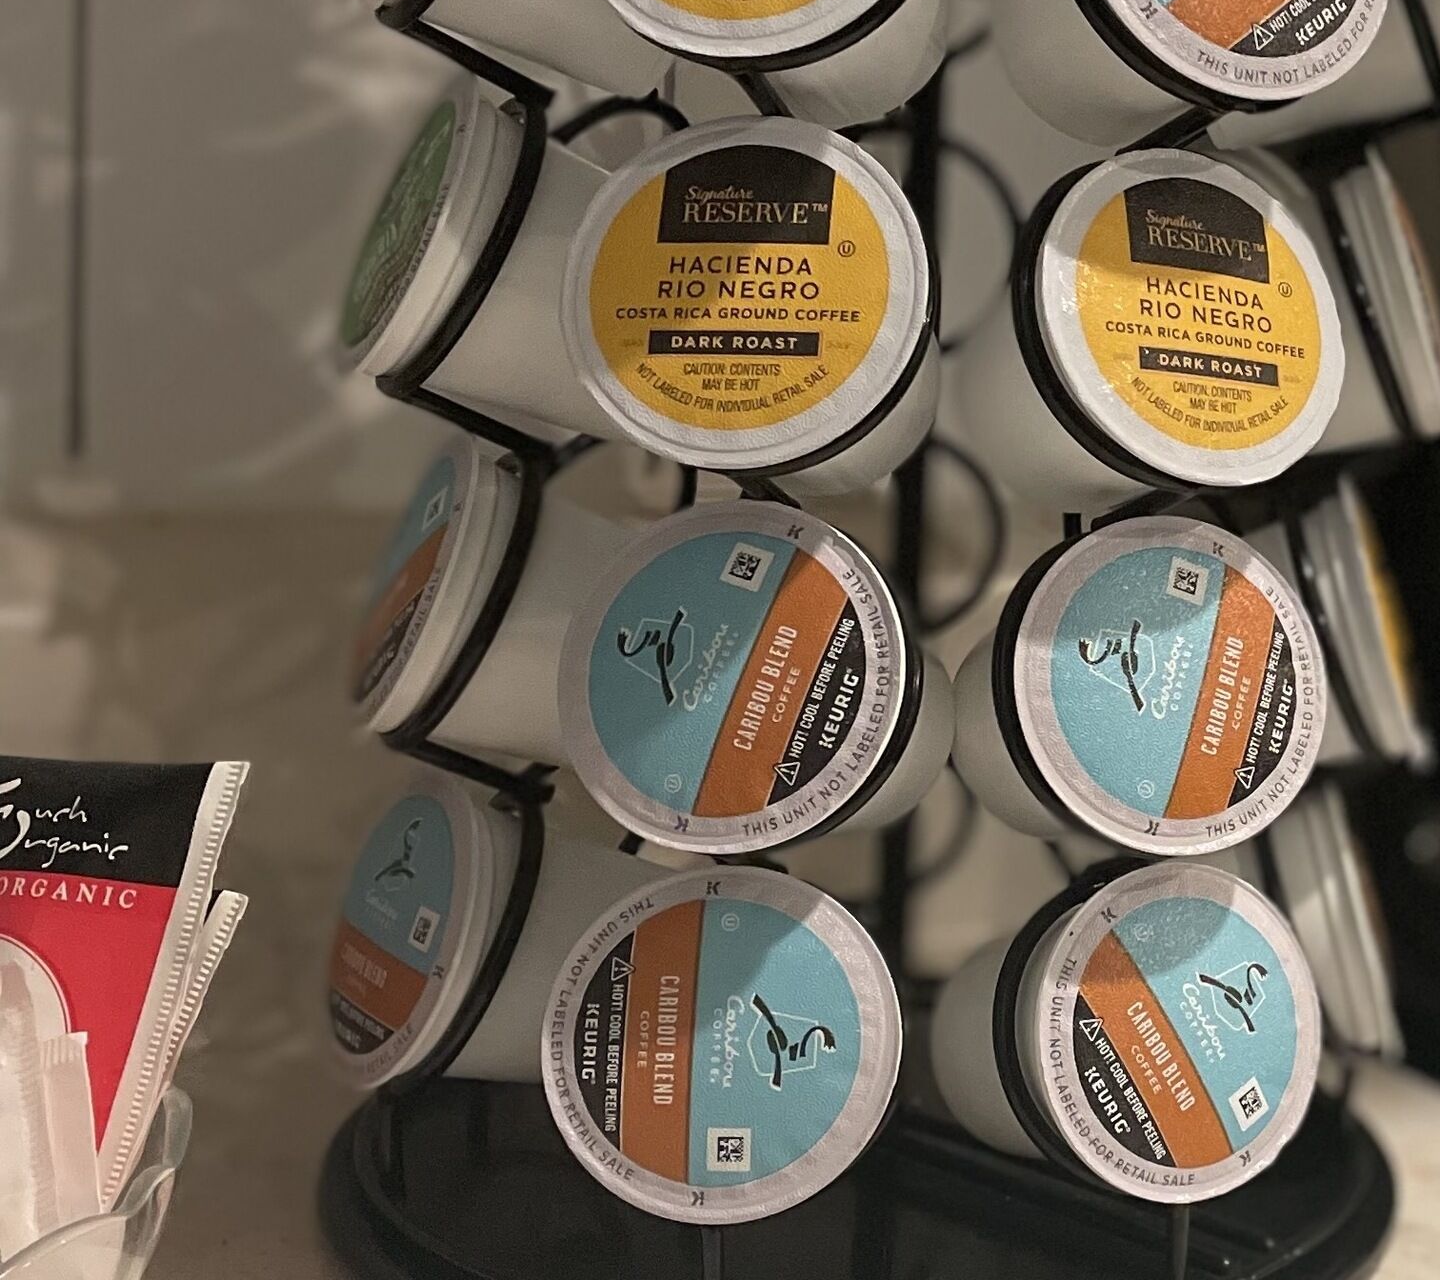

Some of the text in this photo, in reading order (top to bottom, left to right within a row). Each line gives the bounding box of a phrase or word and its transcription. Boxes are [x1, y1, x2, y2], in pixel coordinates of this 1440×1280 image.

[1197, 50, 1228, 77] THIS
[1234, 66, 1267, 84] UNIT
[1273, 68, 1299, 85] NOT
[1304, 39, 1352, 78] LABELED
[1348, 10, 1369, 44] FOR
[685, 185, 754, 203] Signature
[1145, 210, 1203, 230] Signature
[657, 280, 820, 300] RIO NEGRO
[670, 256, 812, 276] HACIENDA
[1146, 277, 1263, 310] HACIENDA
[616, 308, 861, 323] COSTA RICA GROUND COFFEE
[671, 336, 798, 350] DARK ROAST
[1106, 321, 1305, 359] COSTA RICA GROUND COFFEE
[1139, 299, 1272, 333] RIO NEGRO
[636, 362, 652, 384] NOT
[652, 379, 692, 406] LABELED
[693, 395, 714, 410] FOR
[771, 383, 805, 406] RETAIL
[802, 364, 830, 388] SALE
[702, 378, 760, 391] MAY BE HOT
[730, 364, 781, 377] CONTENTS
[1158, 353, 1204, 370] DARK
[1211, 361, 1262, 378] ROAST
[1131, 376, 1289, 430] NOT LABELED FOR RETAIL SALE
[682, 624, 729, 712] Caribou
[733, 626, 798, 752] CARIBOU BLEND
[772, 667, 800, 722] COFFEE
[788, 618, 855, 757] HOT! COOL BEFORE PEELING
[1150, 636, 1184, 720] Caribou
[1200, 637, 1244, 756] CARIBOU BLEND
[742, 568, 890, 837] THIS UNIT NOT LABELED FOR RETAIL SALE
[1205, 587, 1313, 838] THIS UNIT NOT LABELED FOR RETAIL SALE
[1232, 677, 1252, 731] COFFEE
[1246, 632, 1285, 764] HOT! COOL BEFORE PEELING
[551, 896, 654, 1181] THIS UNIT NOT LABELED FOR RETAIL SALE
[637, 1010, 649, 1069] COFFEE
[653, 975, 680, 1106] CARIBOU BLEND
[720, 994, 744, 1089] Caribou
[1182, 982, 1226, 1060] Caribou
[604, 983, 625, 1133] HOT! COOL BEFORE PEELING
[1049, 958, 1195, 1187] THIS UNIT NOT LABELED FOR RETAIL SALE
[1126, 1001, 1197, 1113] CARIBOU BLEND
[1131, 1044, 1161, 1095] COFFEE
[1095, 1036, 1166, 1160] HOT! COOL BEFORE PEELING
